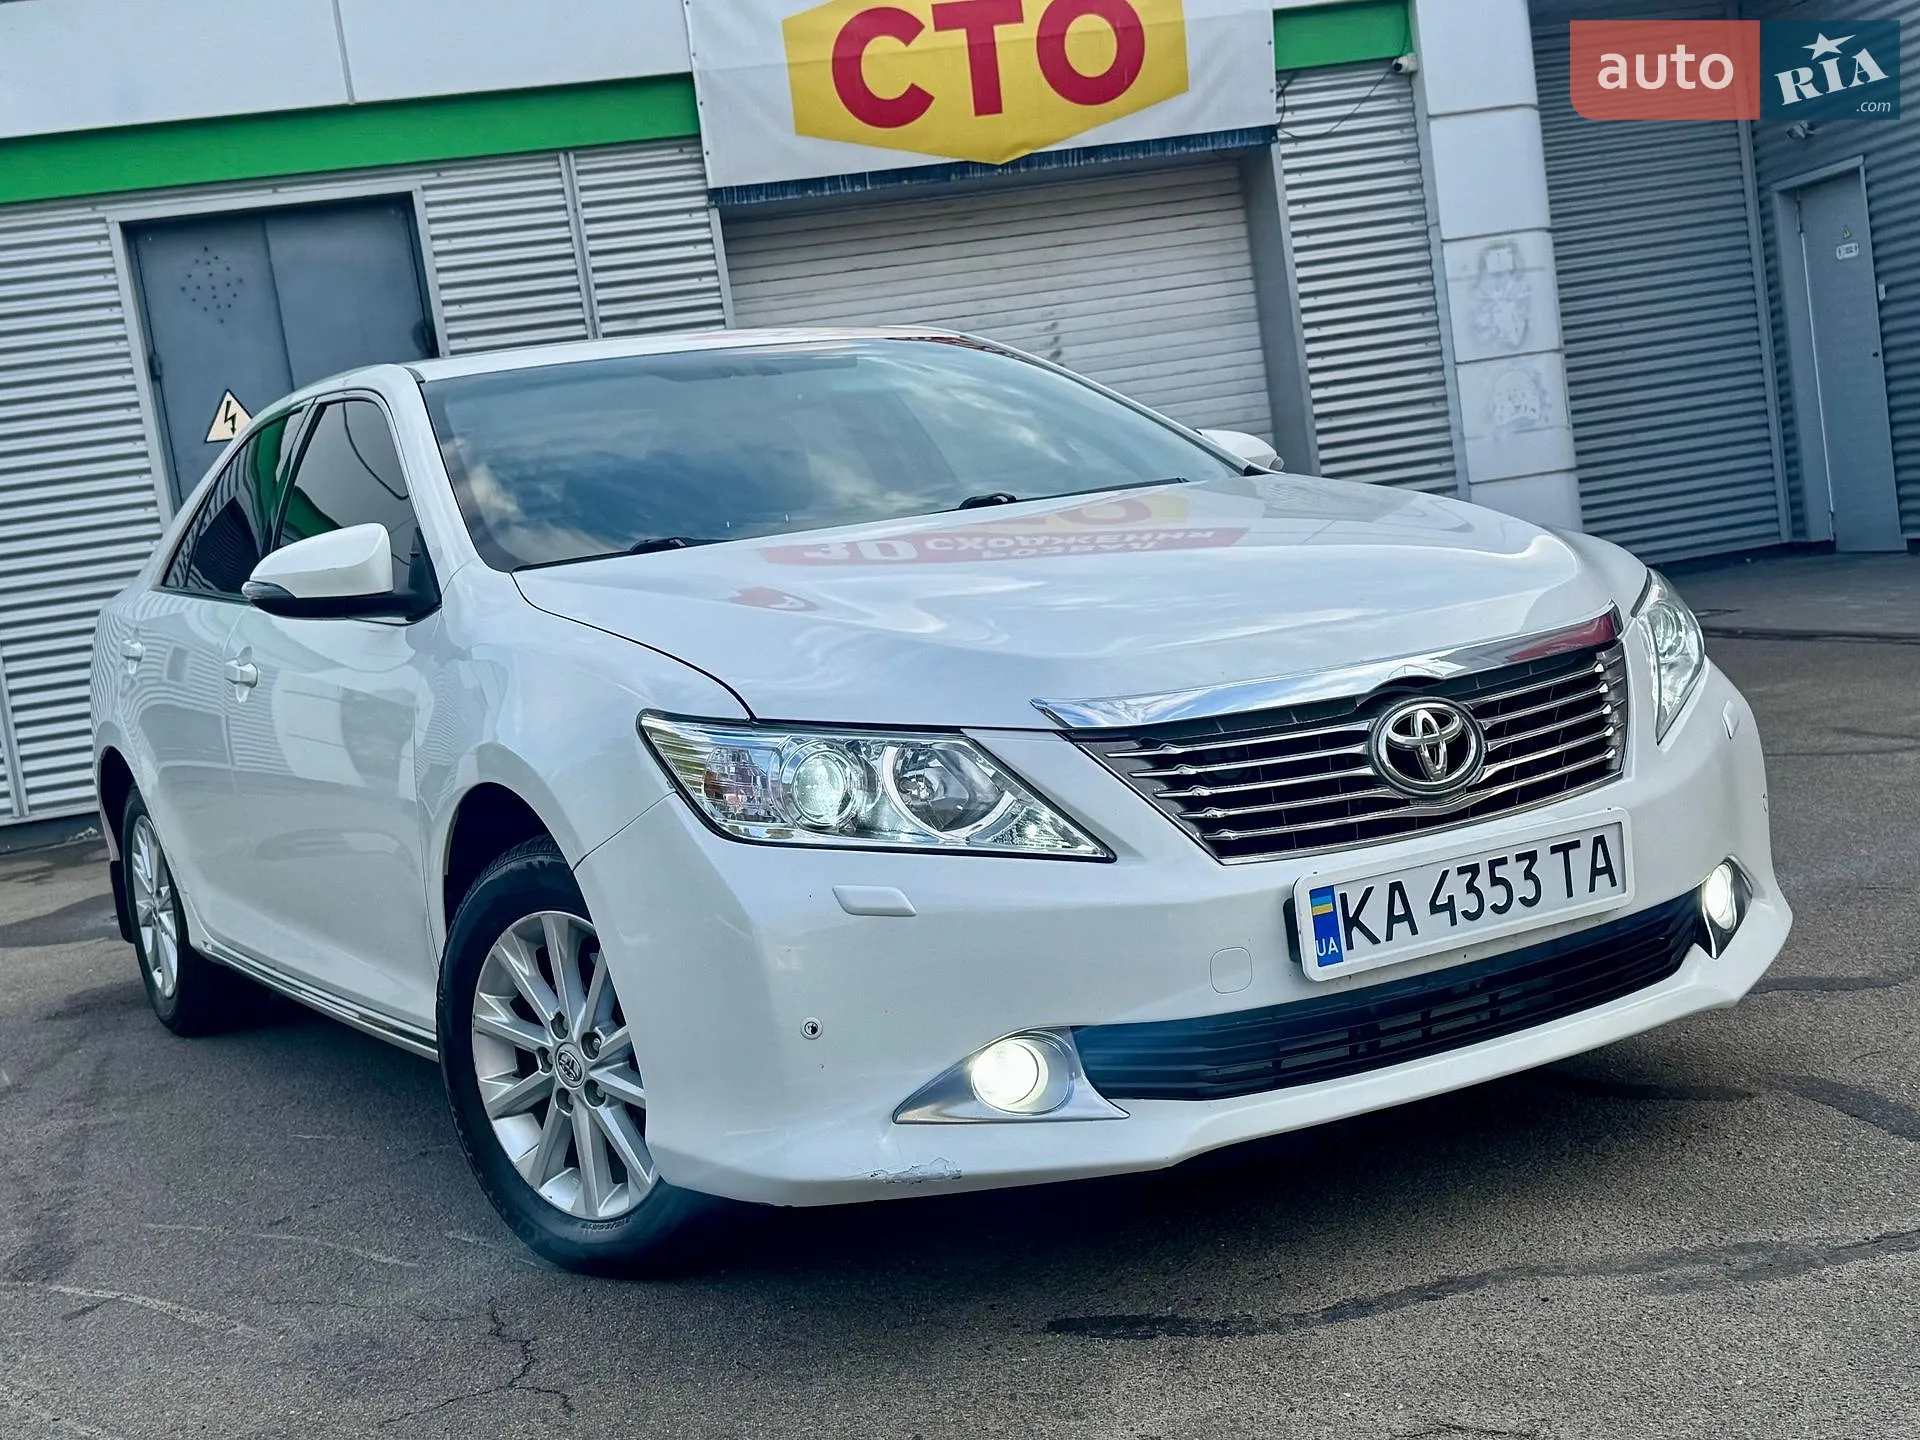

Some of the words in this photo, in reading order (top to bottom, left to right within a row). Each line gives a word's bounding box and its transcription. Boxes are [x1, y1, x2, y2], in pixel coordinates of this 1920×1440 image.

[831, 0, 1145, 129] СТО
[1314, 938, 1340, 957] UA
[1339, 881, 1419, 951] KA
[1429, 850, 1542, 926] 4353
[1550, 835, 1617, 898] TA
